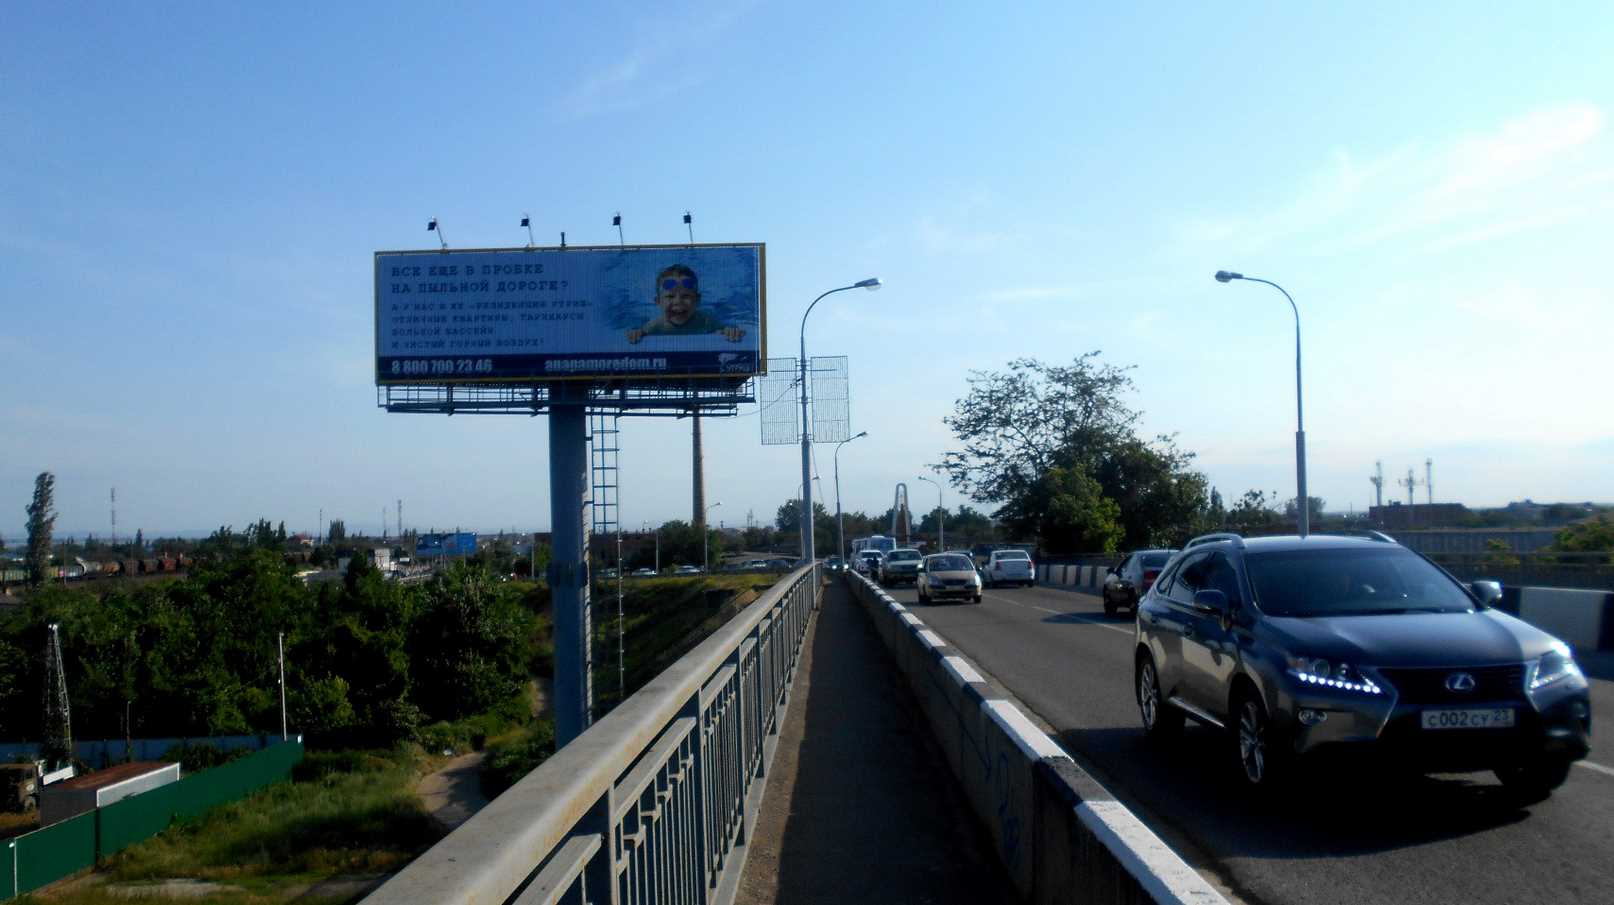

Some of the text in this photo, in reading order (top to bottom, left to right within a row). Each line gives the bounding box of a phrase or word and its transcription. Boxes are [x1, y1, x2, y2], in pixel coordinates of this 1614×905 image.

[391, 263, 544, 277] ВСЕ ЕЩЕ В ПРОБКЕ
[391, 280, 569, 294] НА ПЫЛЬНОЙ ДОРОГЕ?
[391, 358, 492, 374] 8 800 700 23 46
[544, 356, 667, 372] anapamoredom.ru
